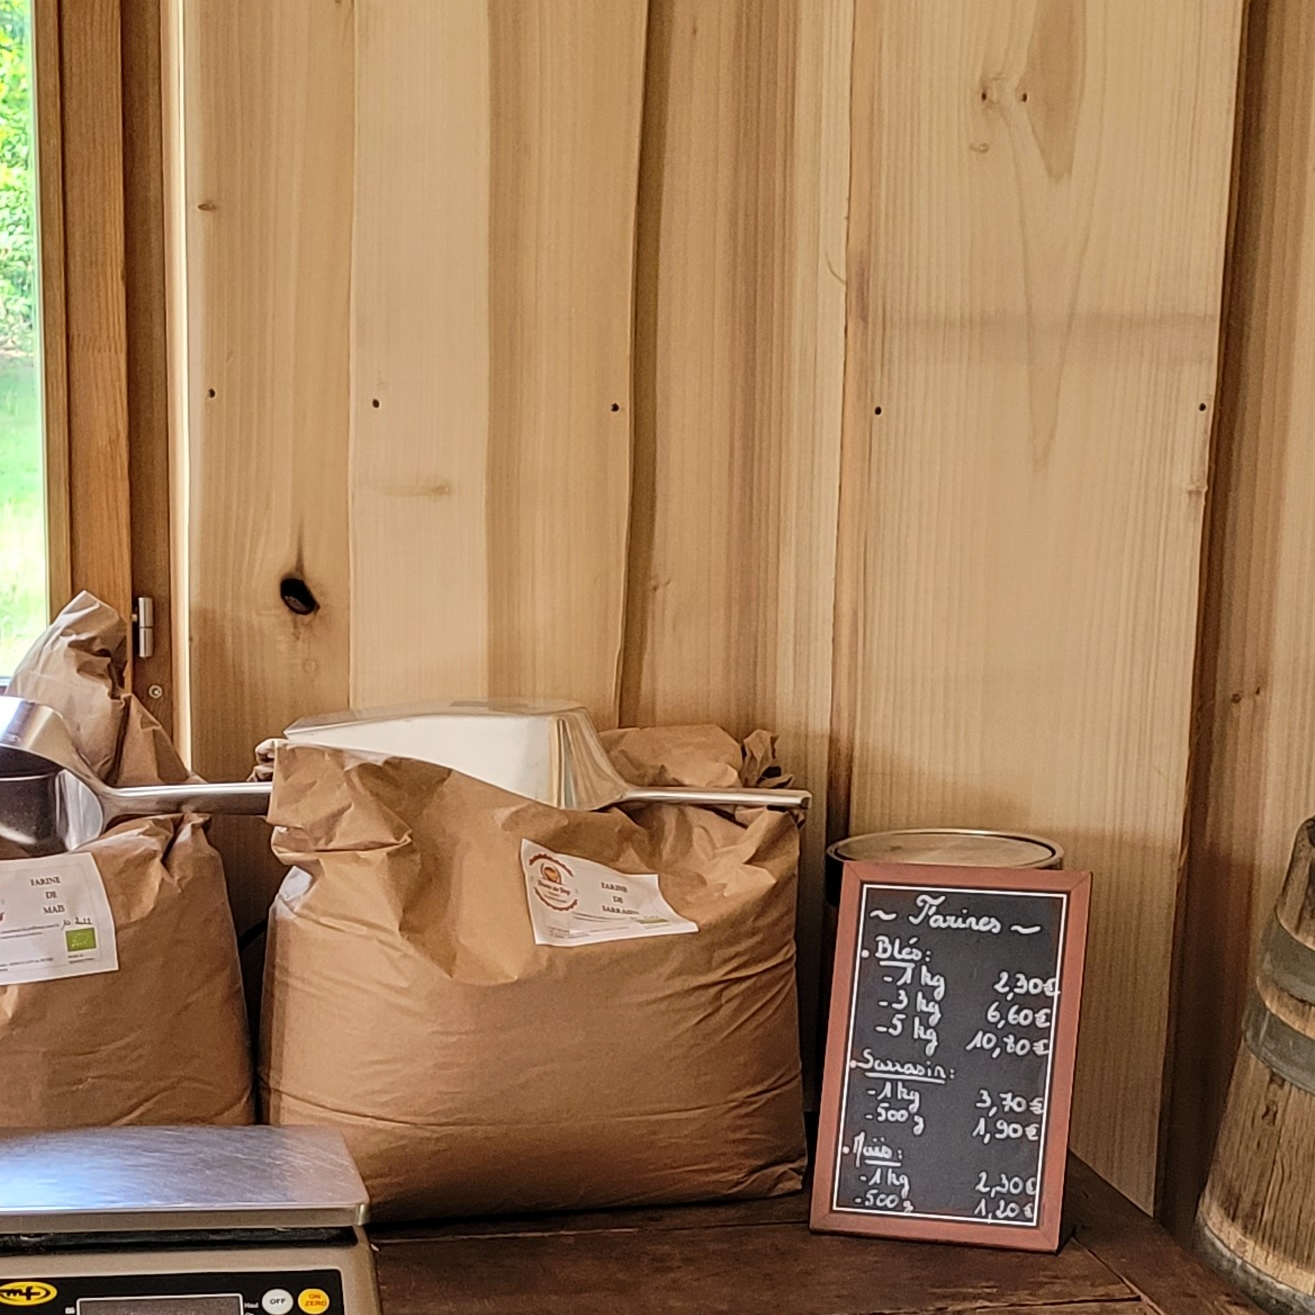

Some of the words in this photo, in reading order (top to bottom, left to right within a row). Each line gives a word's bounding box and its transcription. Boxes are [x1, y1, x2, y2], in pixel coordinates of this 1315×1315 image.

[30, 876, 61, 886] FARINE
[45, 891, 57, 899] DE
[908, 895, 1001, 933] Farines
[921, 965, 945, 1001] kg
[993, 971, 1061, 1001] 2,30€
[916, 991, 941, 1026] kg
[987, 1001, 1051, 1029] 6,60€
[913, 1016, 938, 1056] kg
[897, 1081, 920, 1113] kg
[975, 1089, 1044, 1117] 3,70€
[913, 1115, 925, 1135] g
[972, 1117, 1039, 1144] 1,90€
[887, 1168, 910, 1198] kg
[975, 1172, 1036, 1198] 2,30€
